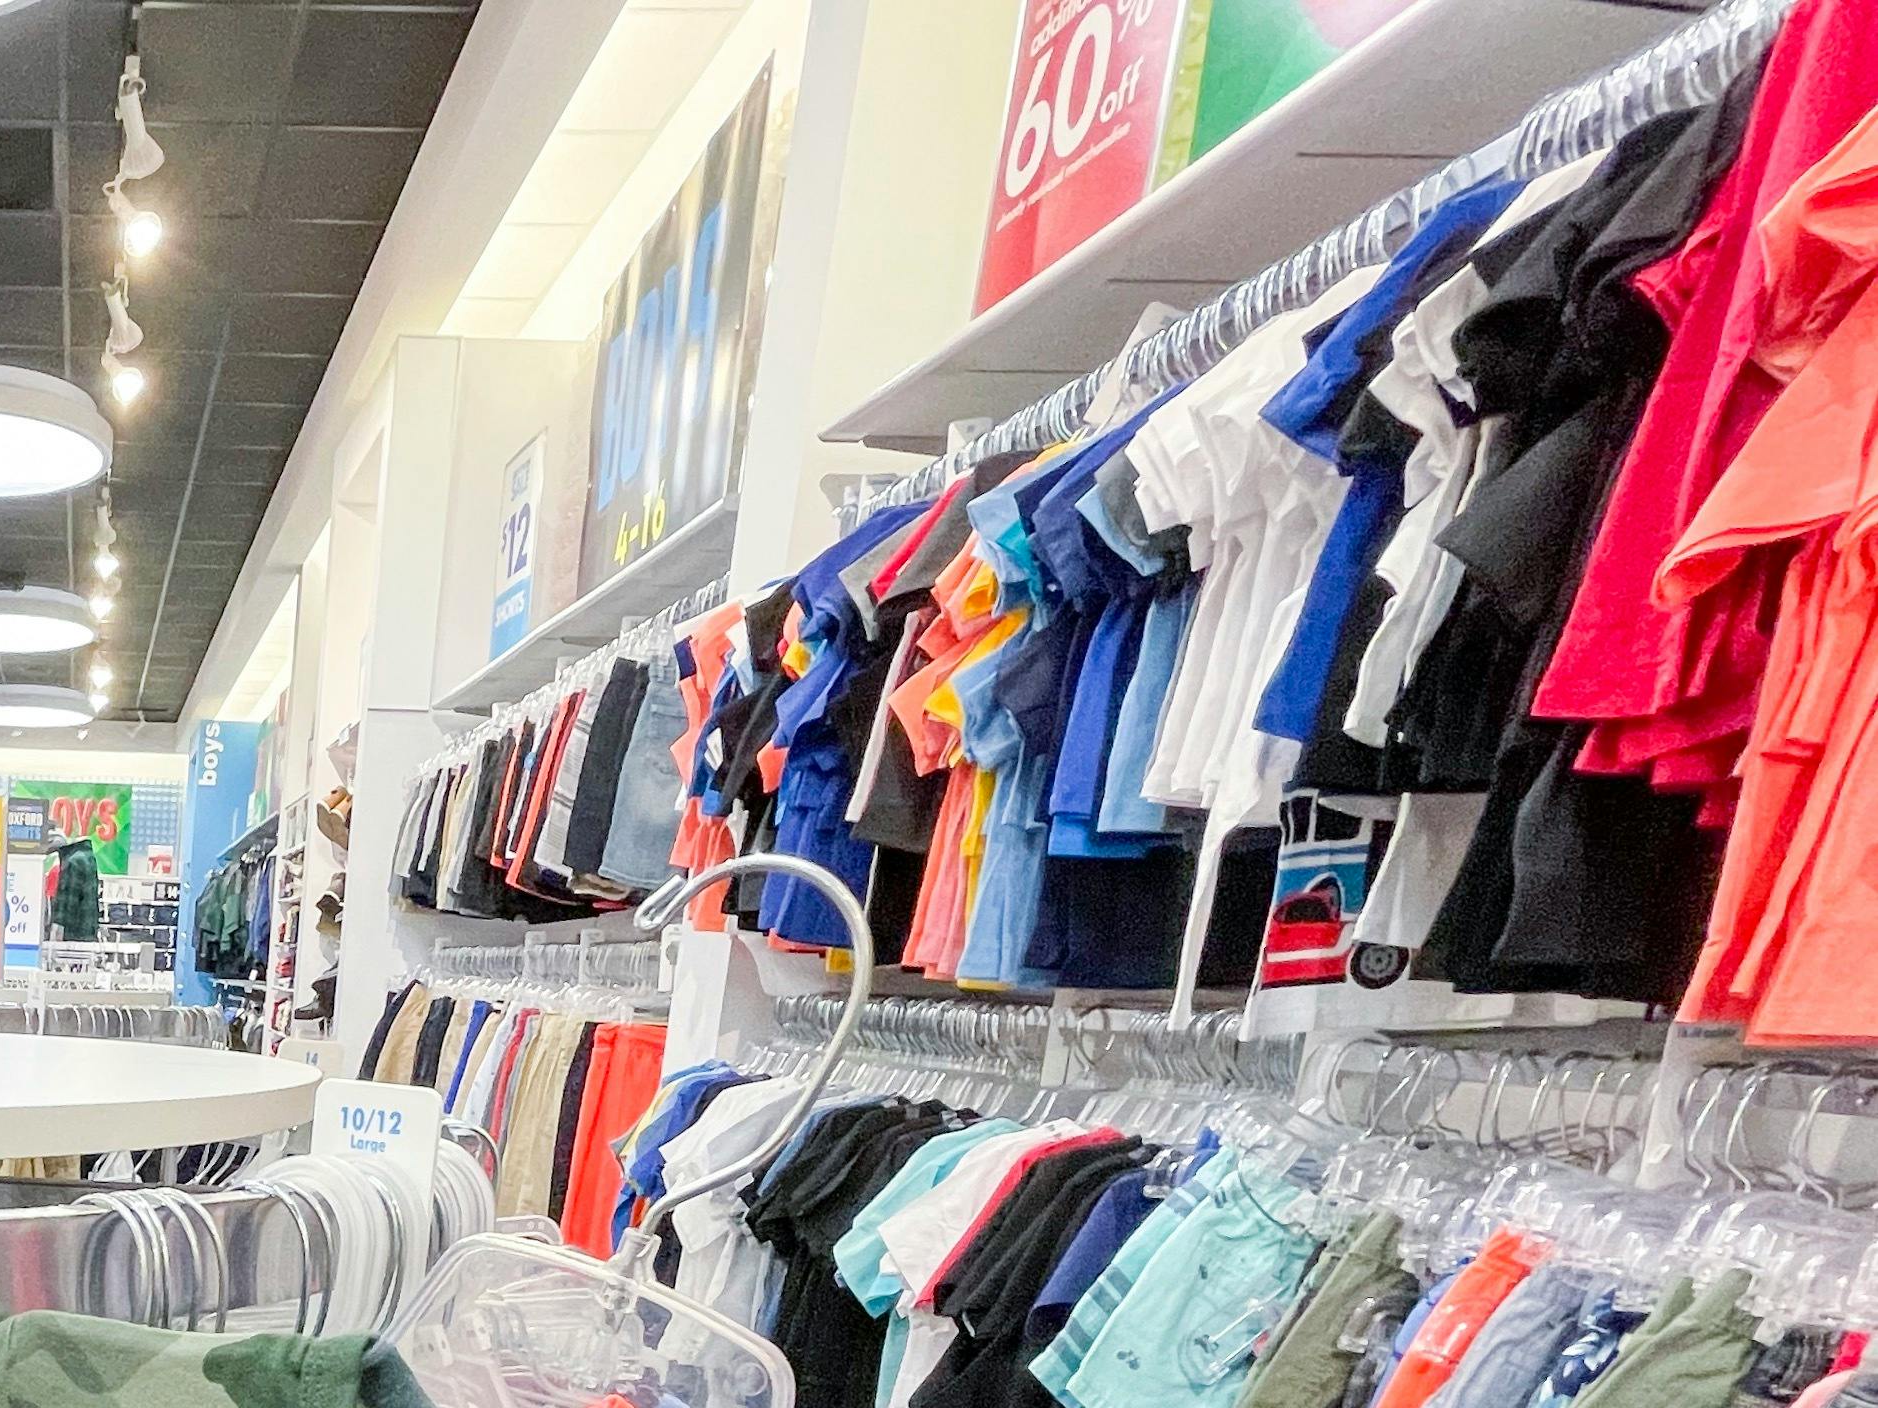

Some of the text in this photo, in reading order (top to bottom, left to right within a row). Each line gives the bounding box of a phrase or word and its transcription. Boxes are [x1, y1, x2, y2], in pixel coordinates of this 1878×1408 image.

[1100, 55, 1144, 124] off
[614, 479, 666, 566] 4-16
[198, 721, 224, 786] boys
[340, 1106, 402, 1135] 10/12
[350, 1135, 386, 1154] Large
